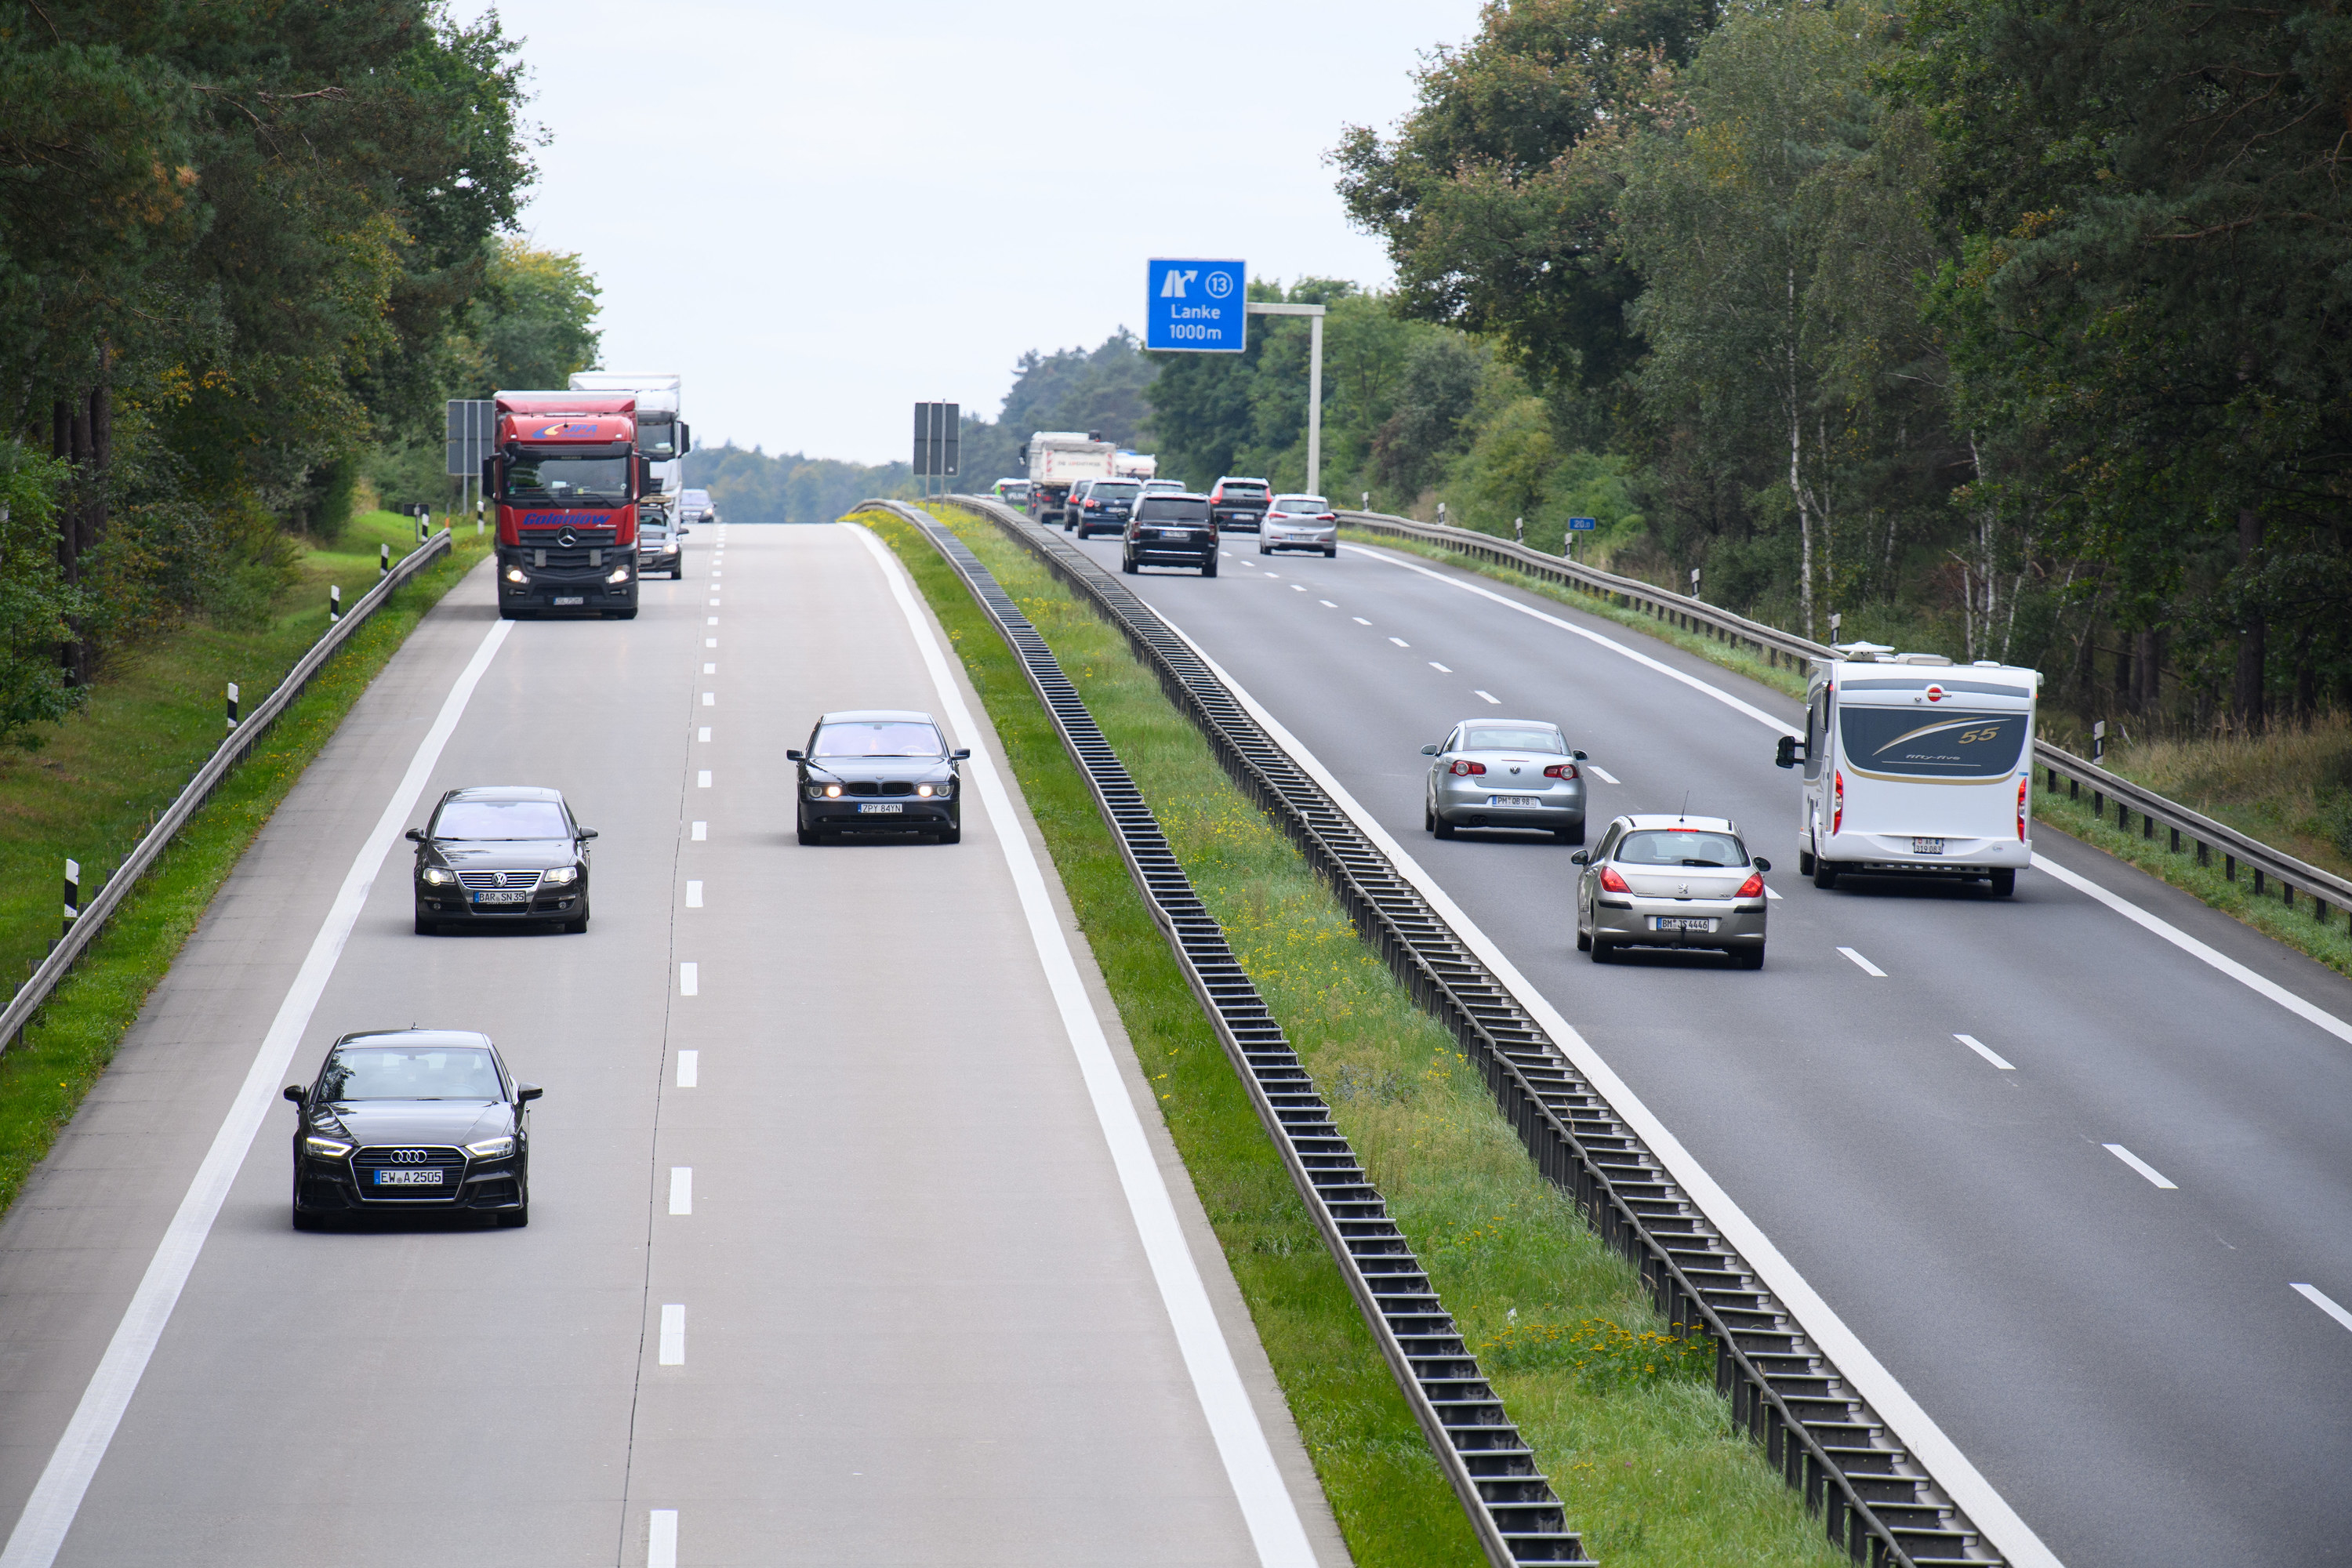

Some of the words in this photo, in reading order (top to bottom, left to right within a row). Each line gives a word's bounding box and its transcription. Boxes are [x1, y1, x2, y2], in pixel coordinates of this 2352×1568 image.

[1211, 277, 1228, 292] 13
[1171, 303, 1221, 321] Lanke
[564, 424, 597, 433] JPA
[523, 512, 611, 525] Goleniów
[1958, 727, 2001, 744] 55
[862, 804, 878, 813] ZPY
[479, 893, 495, 902] BAR
[501, 893, 512, 902] SN
[1662, 919, 1672, 927] BM
[1689, 920, 1708, 929] 4446
[381, 1172, 396, 1183] EW
[404, 1172, 411, 1183] A
[413, 1171, 441, 1183] 2505
